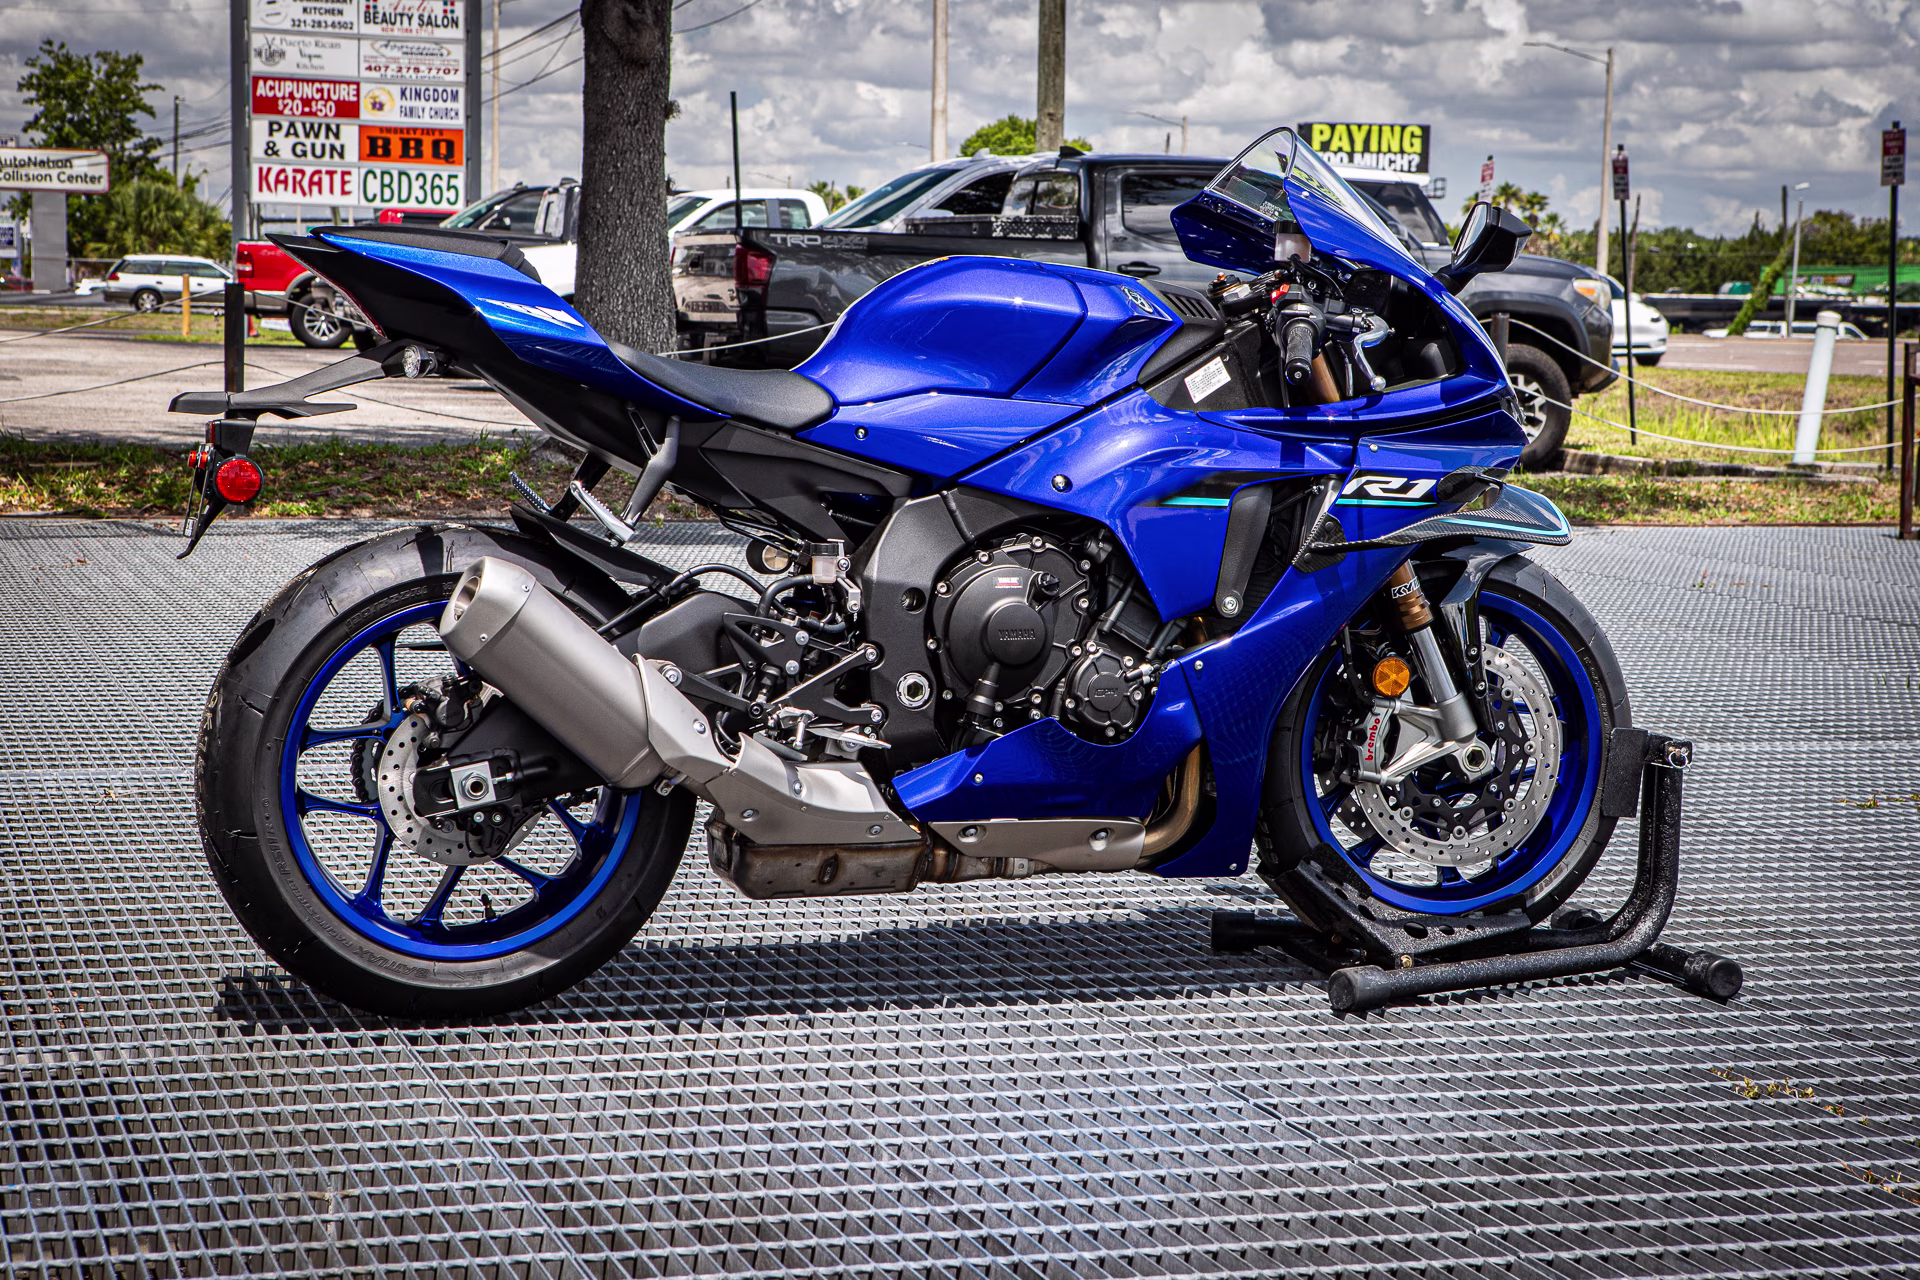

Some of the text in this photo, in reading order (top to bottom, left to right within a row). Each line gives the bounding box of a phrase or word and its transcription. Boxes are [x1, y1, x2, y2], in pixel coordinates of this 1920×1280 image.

[302, 6, 344, 16] KITCHEN
[364, 10, 459, 29] BEAUTY SALON
[291, 18, 354, 30] 321-283-6502
[256, 79, 358, 102] ACUPUNCTURE
[400, 86, 459, 103] KINGDOM
[400, 105, 460, 120] FAMILY CHURCH
[268, 120, 340, 140] PAWN
[1312, 123, 1423, 154] PAYING
[264, 140, 345, 160] & GUN
[366, 135, 456, 165] BBQ
[1353, 152, 1420, 172] MUCH?
[0, 169, 104, 185] ollision Center
[257, 166, 353, 198] KARATE
[363, 168, 459, 206] CBD365
[769, 233, 821, 248] TRD
[1343, 475, 1438, 499] R1
[998, 628, 1035, 641] YAMAHA
[1364, 716, 1381, 762] brembo
[352, 944, 431, 980] BATTLAX
